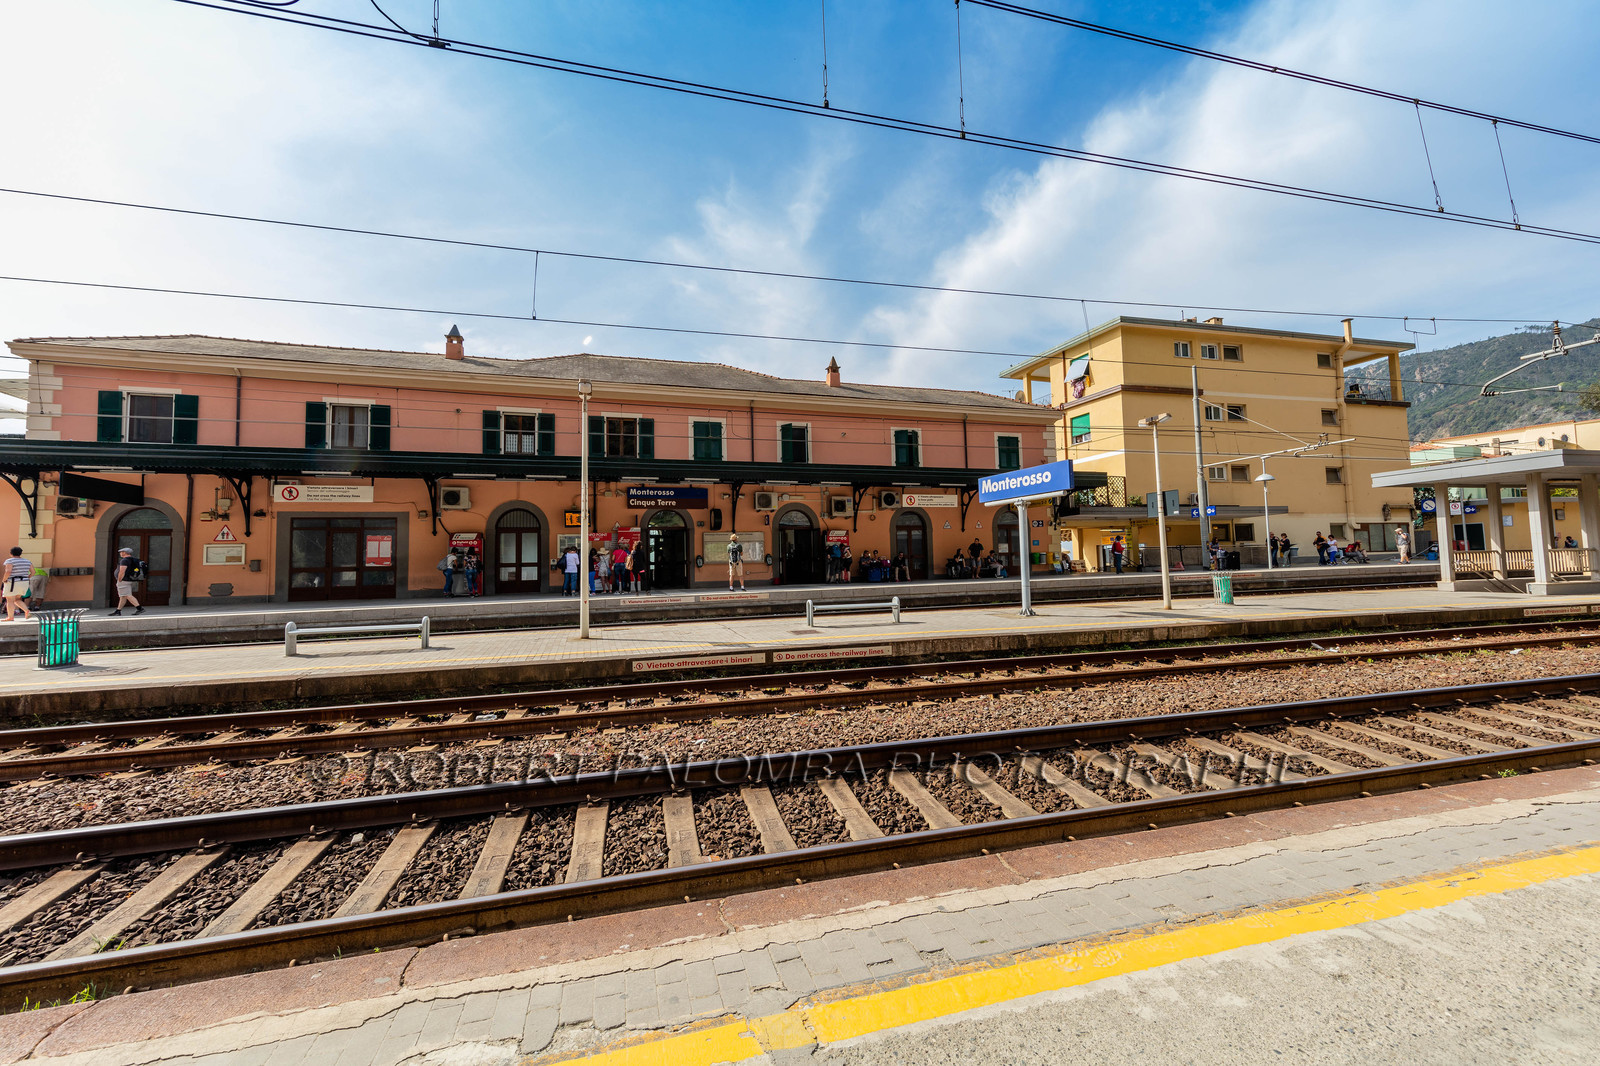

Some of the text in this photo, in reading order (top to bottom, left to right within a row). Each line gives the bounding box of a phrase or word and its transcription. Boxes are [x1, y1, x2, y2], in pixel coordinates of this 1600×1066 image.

[981, 471, 1052, 494] Monterosso
[629, 488, 675, 496] Monterosso
[629, 499, 656, 508] Cinque
[646, 661, 674, 669] Vietato
[676, 658, 724, 667] attraversare
